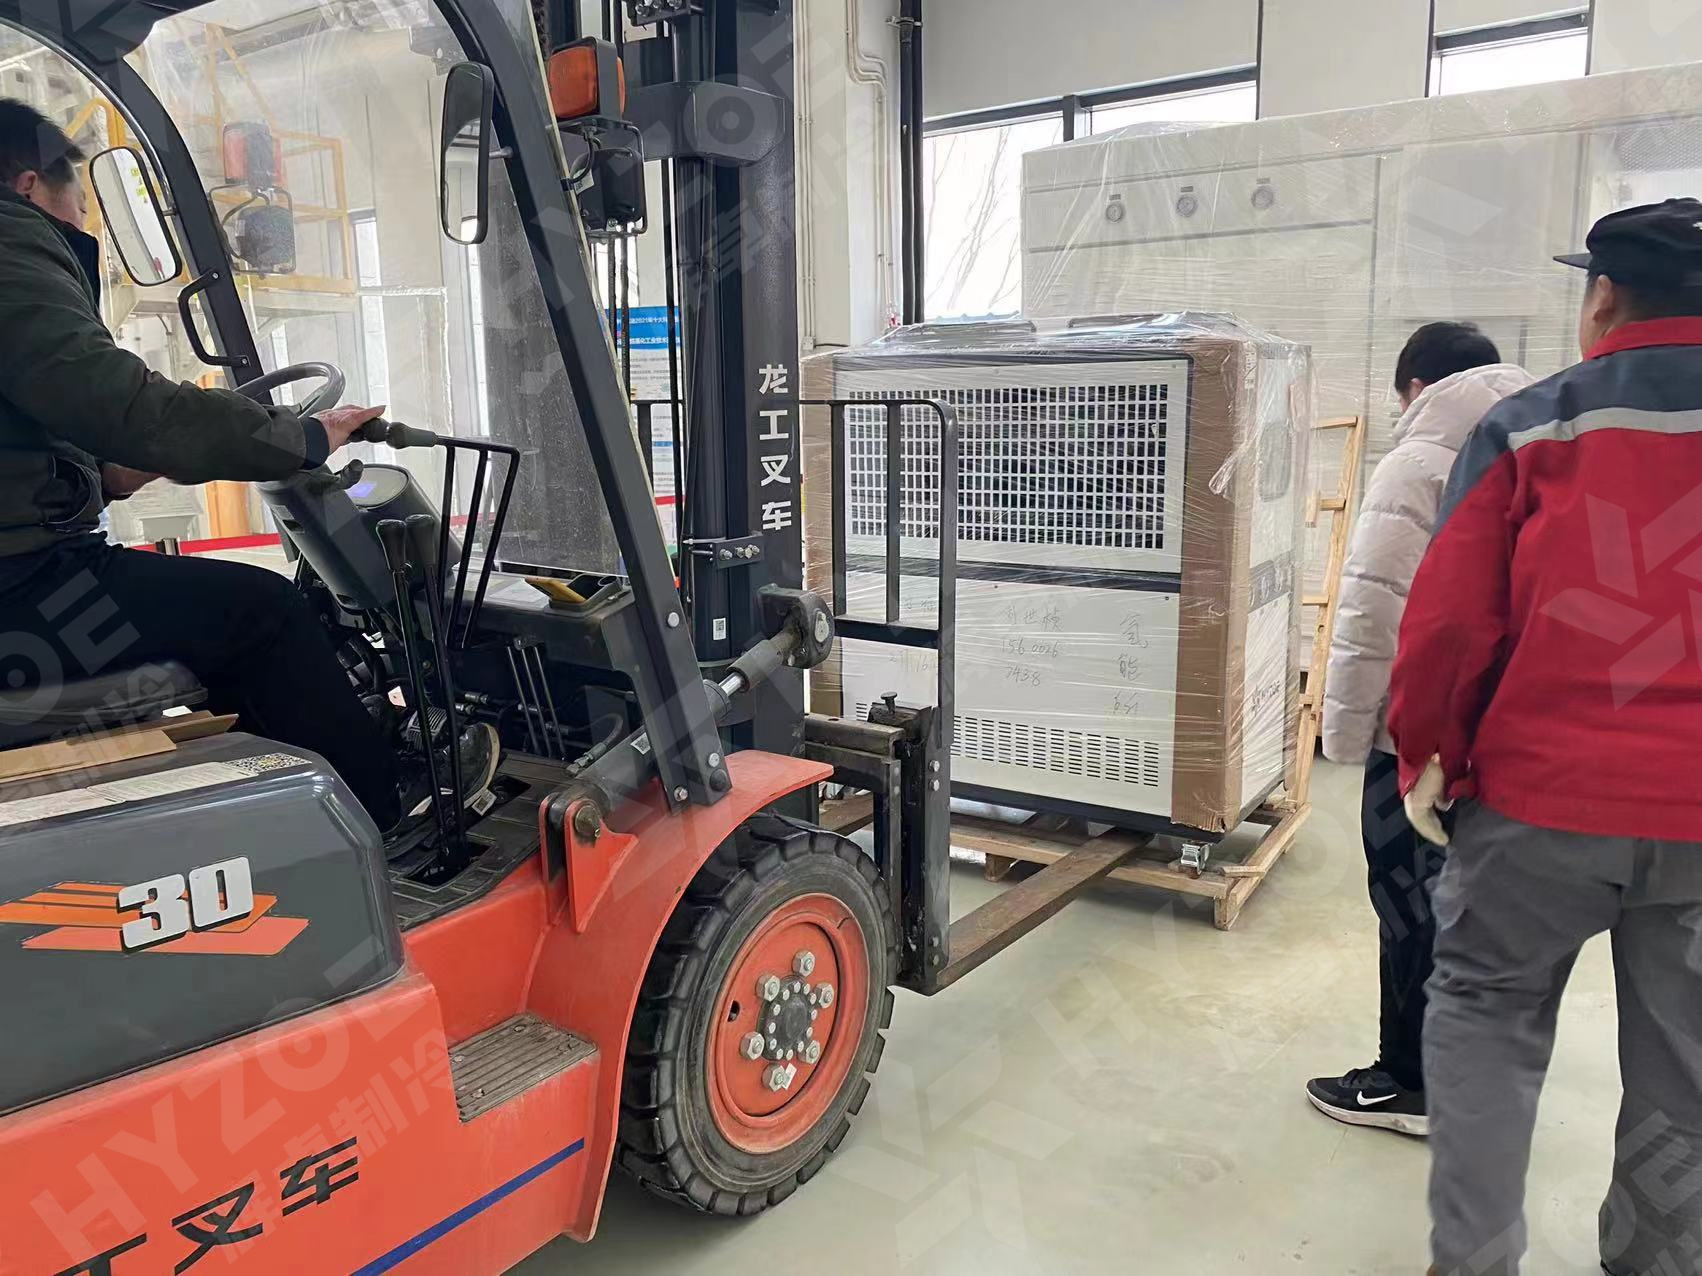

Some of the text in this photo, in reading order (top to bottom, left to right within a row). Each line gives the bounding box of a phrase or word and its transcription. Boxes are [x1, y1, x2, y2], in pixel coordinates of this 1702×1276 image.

[758, 363, 792, 531] 龙工叉车
[1004, 665, 1041, 687] 7438
[117, 856, 254, 952] 30
